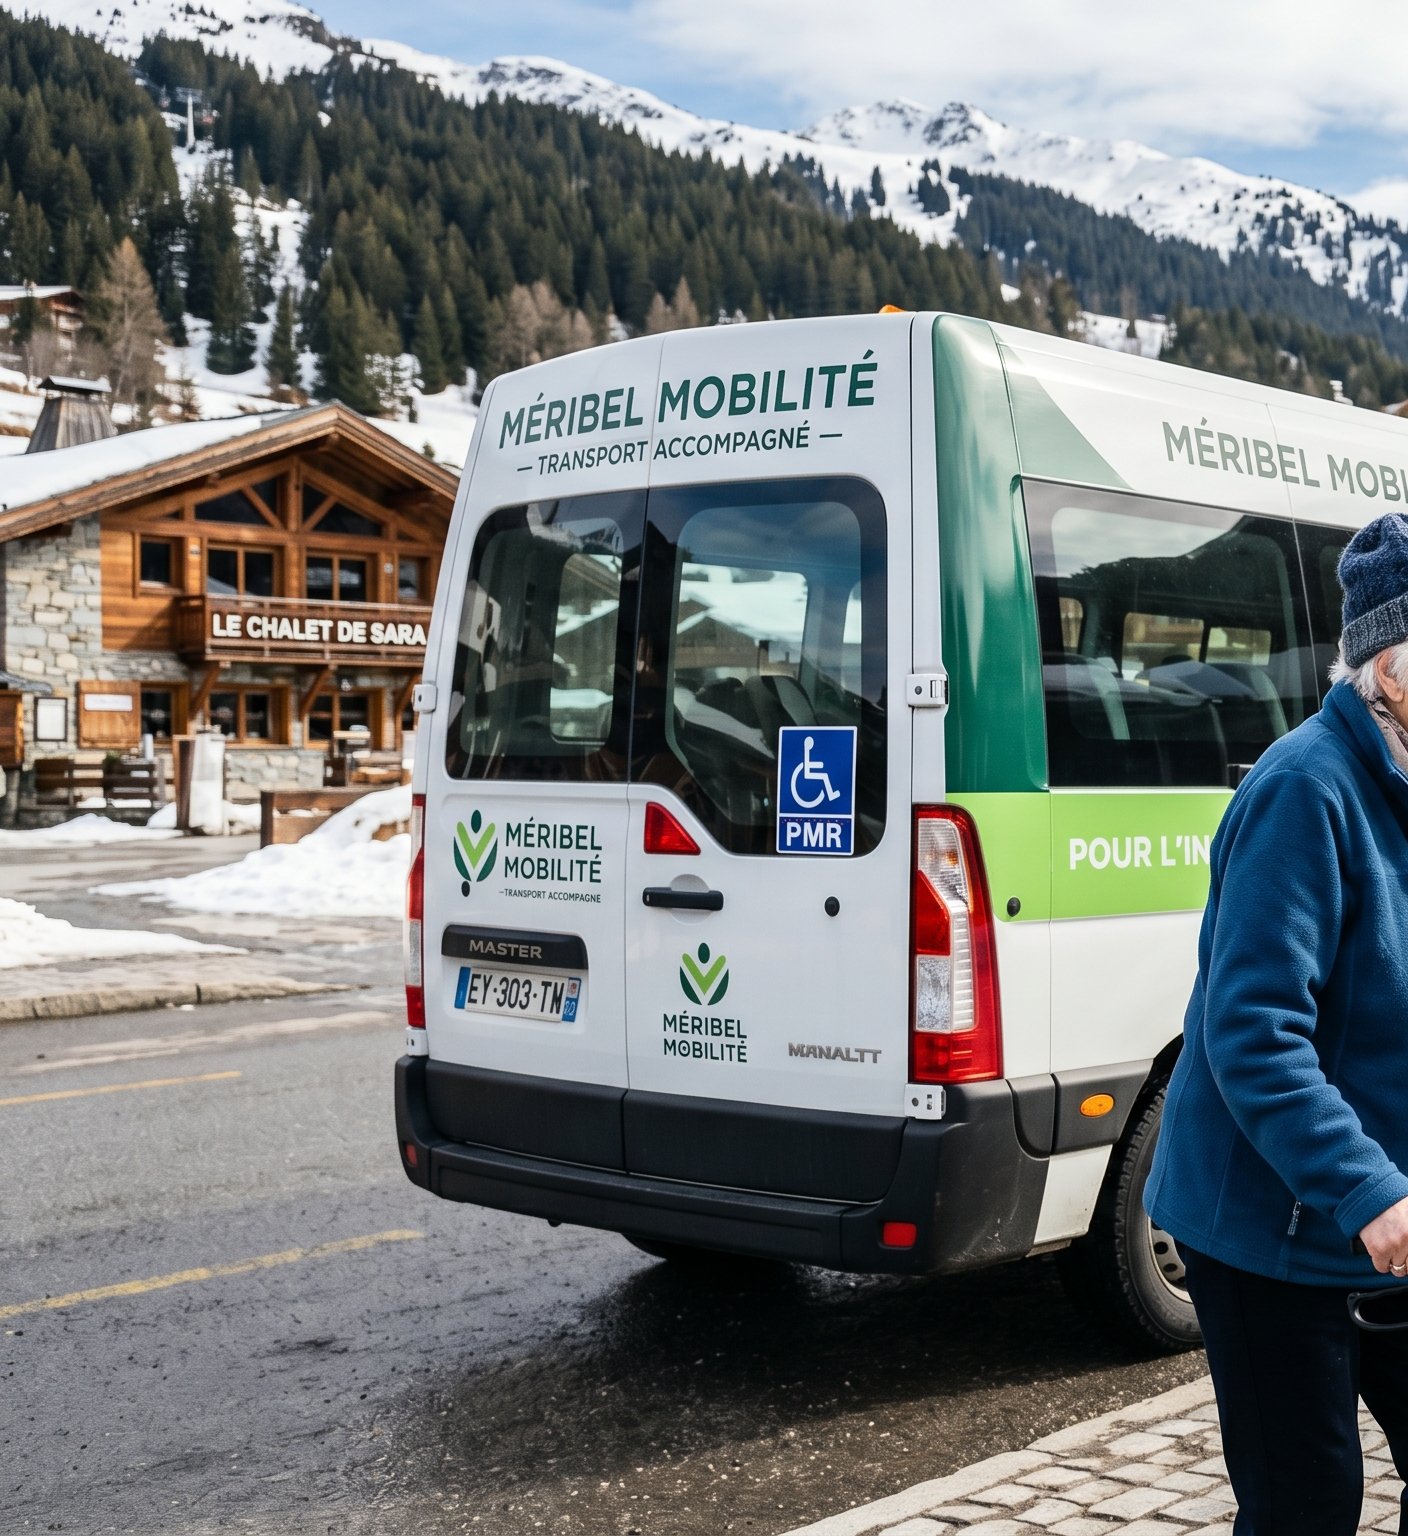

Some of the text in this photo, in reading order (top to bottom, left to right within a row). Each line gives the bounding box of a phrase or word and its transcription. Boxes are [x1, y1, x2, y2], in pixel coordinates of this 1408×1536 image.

[499, 349, 878, 449] MÉRIBEL MOBILITÉ
[538, 420, 810, 475] TRANSPORT ACCOMPAGNÉ
[1161, 417, 1320, 488] MÉRIBEL
[212, 613, 427, 646] LE CHALET DE SARA
[505, 816, 602, 851] MÉRIBEL
[786, 821, 842, 848] PMR
[504, 854, 602, 883] MOBILITÉ
[1069, 836, 1152, 870] POUR
[504, 888, 546, 899] TRANSPORT
[469, 940, 542, 959] MASTER
[663, 1010, 747, 1039] MÉRIBEL
